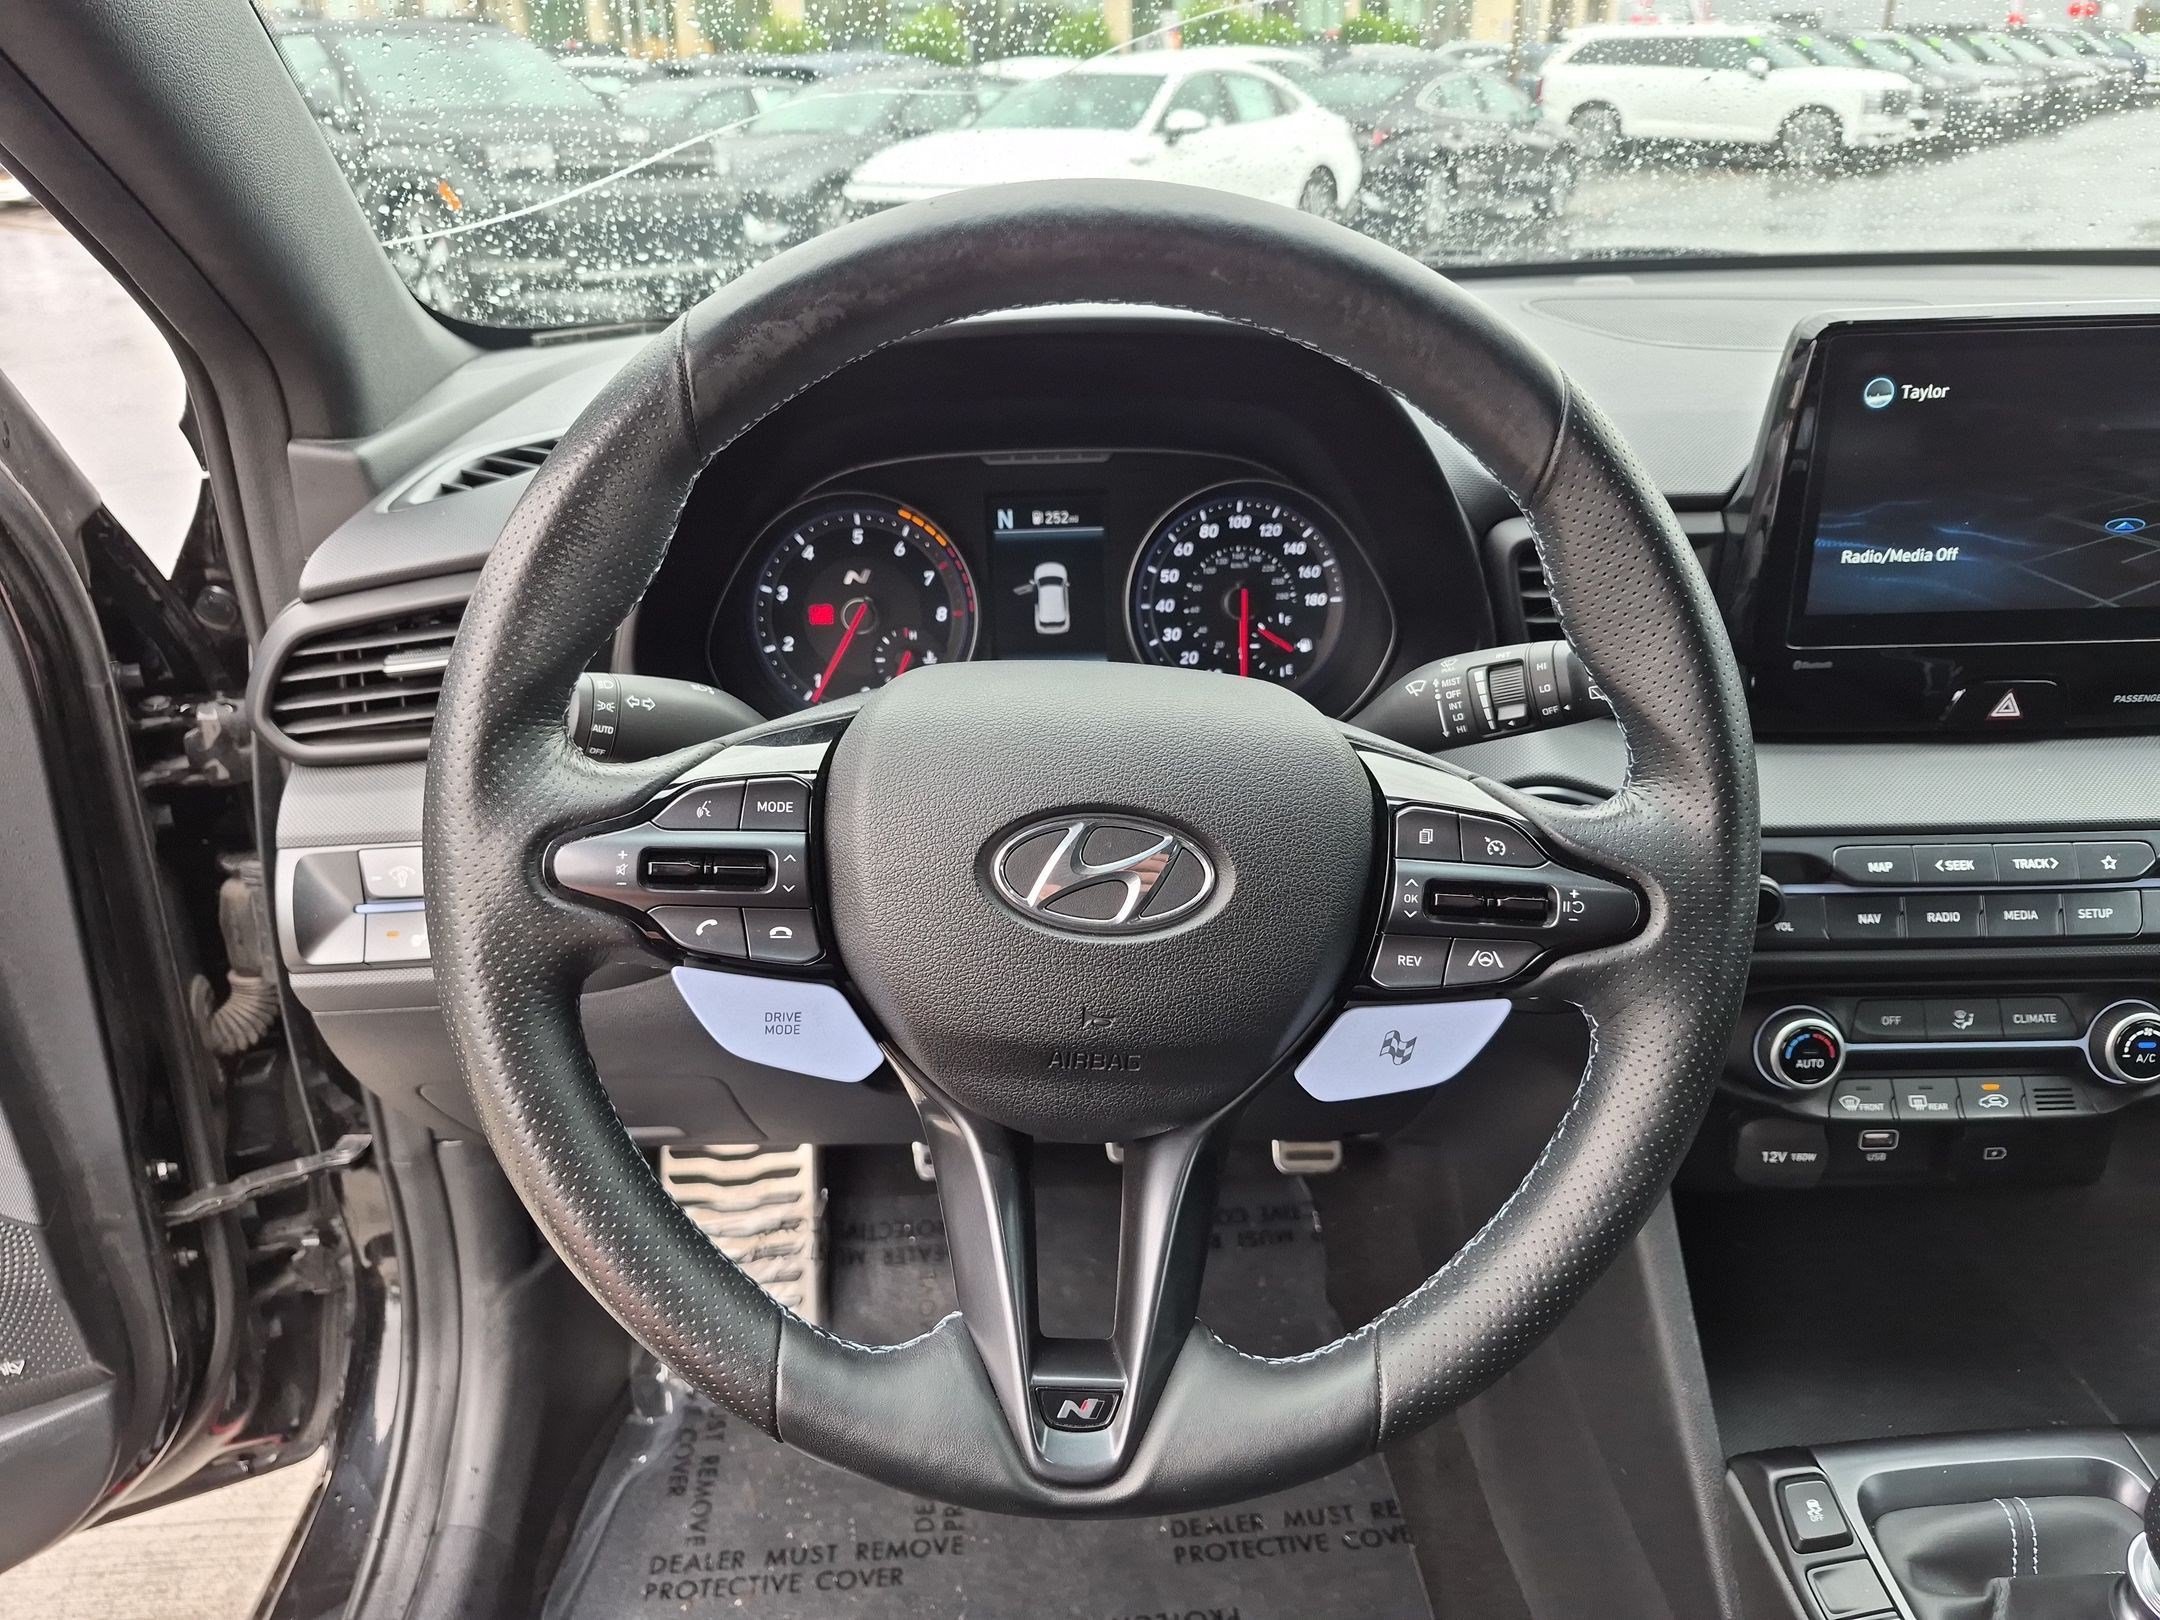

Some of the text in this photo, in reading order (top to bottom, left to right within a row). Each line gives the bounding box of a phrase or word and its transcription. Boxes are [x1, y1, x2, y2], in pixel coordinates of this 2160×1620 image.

[1901, 383, 1950, 402] Taylor
[997, 508, 1014, 529] N
[1228, 514, 1252, 529] 100
[1199, 523, 1219, 539] 80
[1259, 523, 1283, 537] 120
[851, 528, 864, 545] 5
[801, 544, 815, 561] 4
[893, 541, 906, 557] 6
[1173, 542, 1194, 557] 60
[1283, 541, 1307, 556] 140
[1841, 547, 1959, 564] Radio/Media Off
[1160, 569, 1180, 584] 50
[1298, 565, 1322, 579] 160
[923, 570, 935, 587] 7
[776, 585, 789, 602] 3
[1304, 592, 1328, 607] 180
[1155, 599, 1176, 613] 40
[935, 606, 948, 622] 8
[1162, 627, 1182, 642] 30
[782, 636, 795, 652] 2
[1179, 651, 1199, 665] 20
[1536, 662, 1547, 671] HI
[1441, 677, 1461, 688] MIST
[1538, 683, 1551, 694] LO
[1445, 689, 1461, 700] OFF
[1448, 701, 1463, 711] INT
[1541, 705, 1559, 716] OFF
[1452, 713, 1464, 722] LO
[592, 724, 614, 735] AUTO
[1456, 724, 1467, 734] HI
[589, 747, 606, 756] OFF
[757, 801, 794, 813] MODE
[1867, 861, 1893, 873] MAP
[1945, 860, 1975, 872] SEEK
[2012, 858, 2050, 870] TRACK
[1404, 894, 1418, 904] OK
[1857, 913, 1881, 925] NAV
[1926, 912, 1961, 924] RADIO
[2004, 910, 2038, 922] MEDIA
[2078, 908, 2113, 920] SETUP
[1397, 955, 1422, 967] REV
[764, 1012, 802, 1023] DRIVE
[1881, 1015, 1901, 1026] OFF
[2013, 1013, 2057, 1025] CLIMATE
[764, 1024, 801, 1035] MODE
[1048, 1051, 1141, 1072] AIRBAG
[1795, 1058, 1825, 1070] AUTO
[2136, 1053, 2156, 1064] A/C
[1859, 1103, 1884, 1111] FRONT
[1928, 1103, 1949, 1111] REAR
[1762, 1151, 1788, 1163] 12V
[685, 1455, 721, 1548] REMOVE
[1171, 1513, 1264, 1539] DEALER
[1283, 1504, 1354, 1528] MUST
[1174, 1533, 1329, 1565] PROTECTIVE
[649, 1535, 963, 1576] DEALER MUST REMOVE
[643, 1567, 904, 1601] PROTECTIVE COVER
